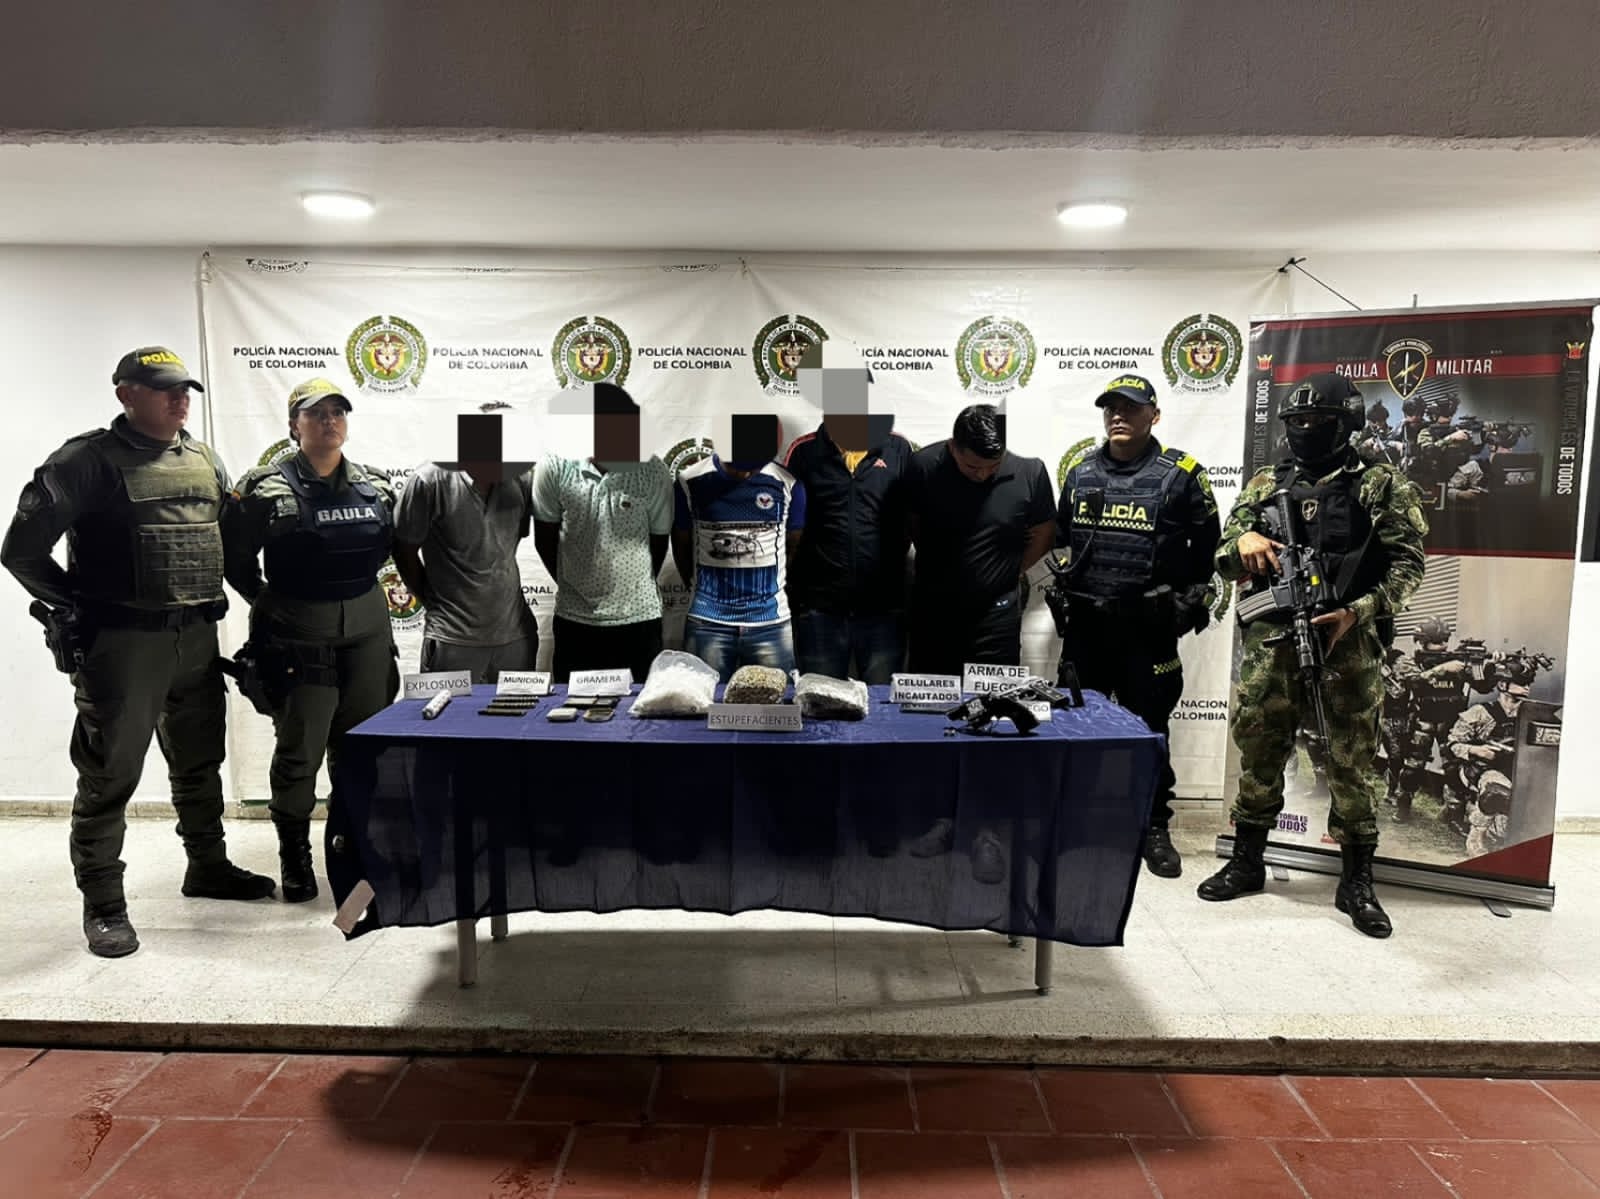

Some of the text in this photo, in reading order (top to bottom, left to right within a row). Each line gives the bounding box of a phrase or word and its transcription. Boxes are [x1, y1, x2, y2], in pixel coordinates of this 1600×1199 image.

[233, 343, 341, 356] POLICÍA NACIONAL
[482, 347, 544, 357] NACIONAL
[638, 343, 747, 357] POLICÍA NACIONAL
[862, 345, 949, 357] ICÍA NACIONAL
[1044, 343, 1155, 356] POLICÍA NACIONAL
[249, 360, 327, 369] DE COLOMBIA
[448, 361, 464, 370] DE
[653, 360, 732, 369] DE COLOMBIA
[872, 361, 934, 371] COLOMBIA
[1058, 360, 1138, 369] DE COLOMBIA
[1335, 359, 1494, 378] GAULA MILITAR
[1255, 379, 1269, 409] TODOS
[1255, 411, 1268, 423] DE
[1560, 447, 1575, 460] DE
[1209, 479, 1237, 487] MBIA
[1557, 462, 1574, 495] TODOS
[318, 507, 376, 521] GAULA
[1078, 501, 1147, 521] PLICÍA
[968, 665, 1025, 678] ARMA DE
[406, 678, 470, 691] EXPLOSIVOS
[576, 675, 622, 684] GRAMERA
[897, 679, 955, 687] CELULARES
[894, 692, 959, 700] INCAUTADOS
[1181, 700, 1228, 709] NACION
[711, 715, 800, 726] ESTUPEFACIENTES
[1168, 711, 1227, 721] OLOMBIA
[1278, 820, 1307, 832] ODOS
